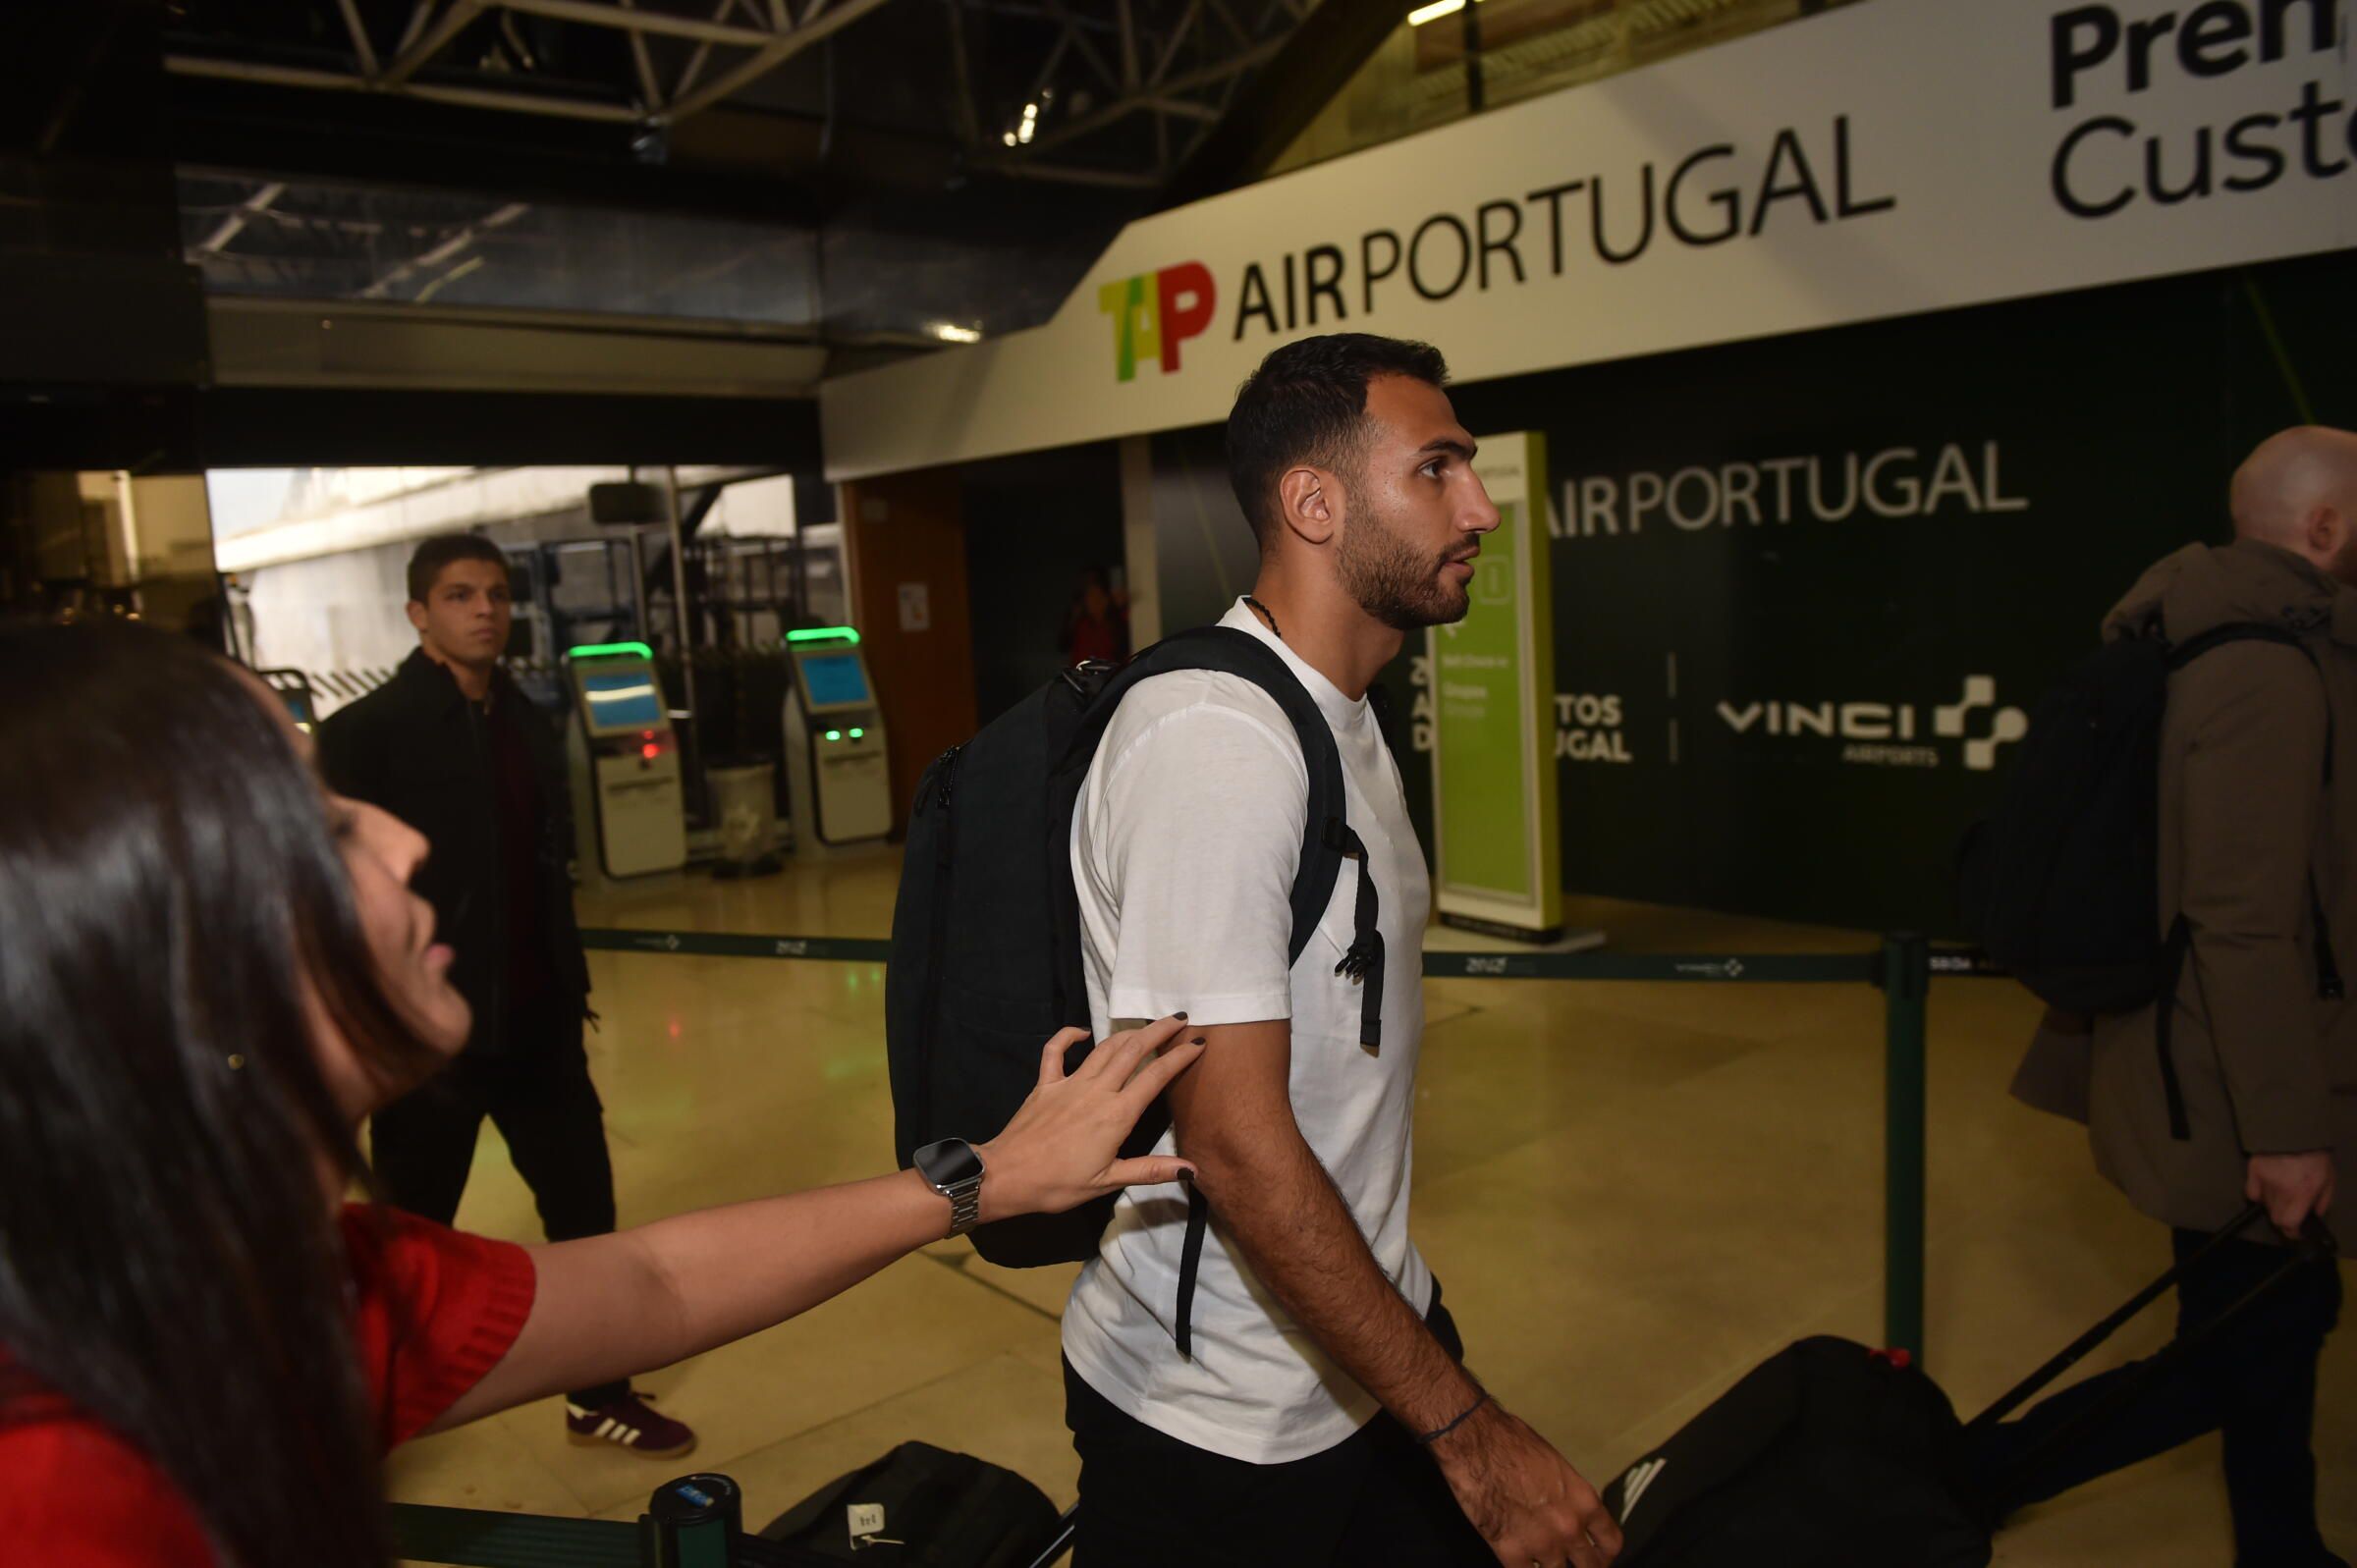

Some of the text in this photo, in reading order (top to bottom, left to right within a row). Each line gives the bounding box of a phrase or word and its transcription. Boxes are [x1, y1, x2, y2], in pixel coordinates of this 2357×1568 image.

[2053, 81, 2357, 220] Cust
[1099, 260, 1217, 383] TAP
[1557, 694, 1622, 725] TOS
[1718, 702, 1915, 740] VINCI
